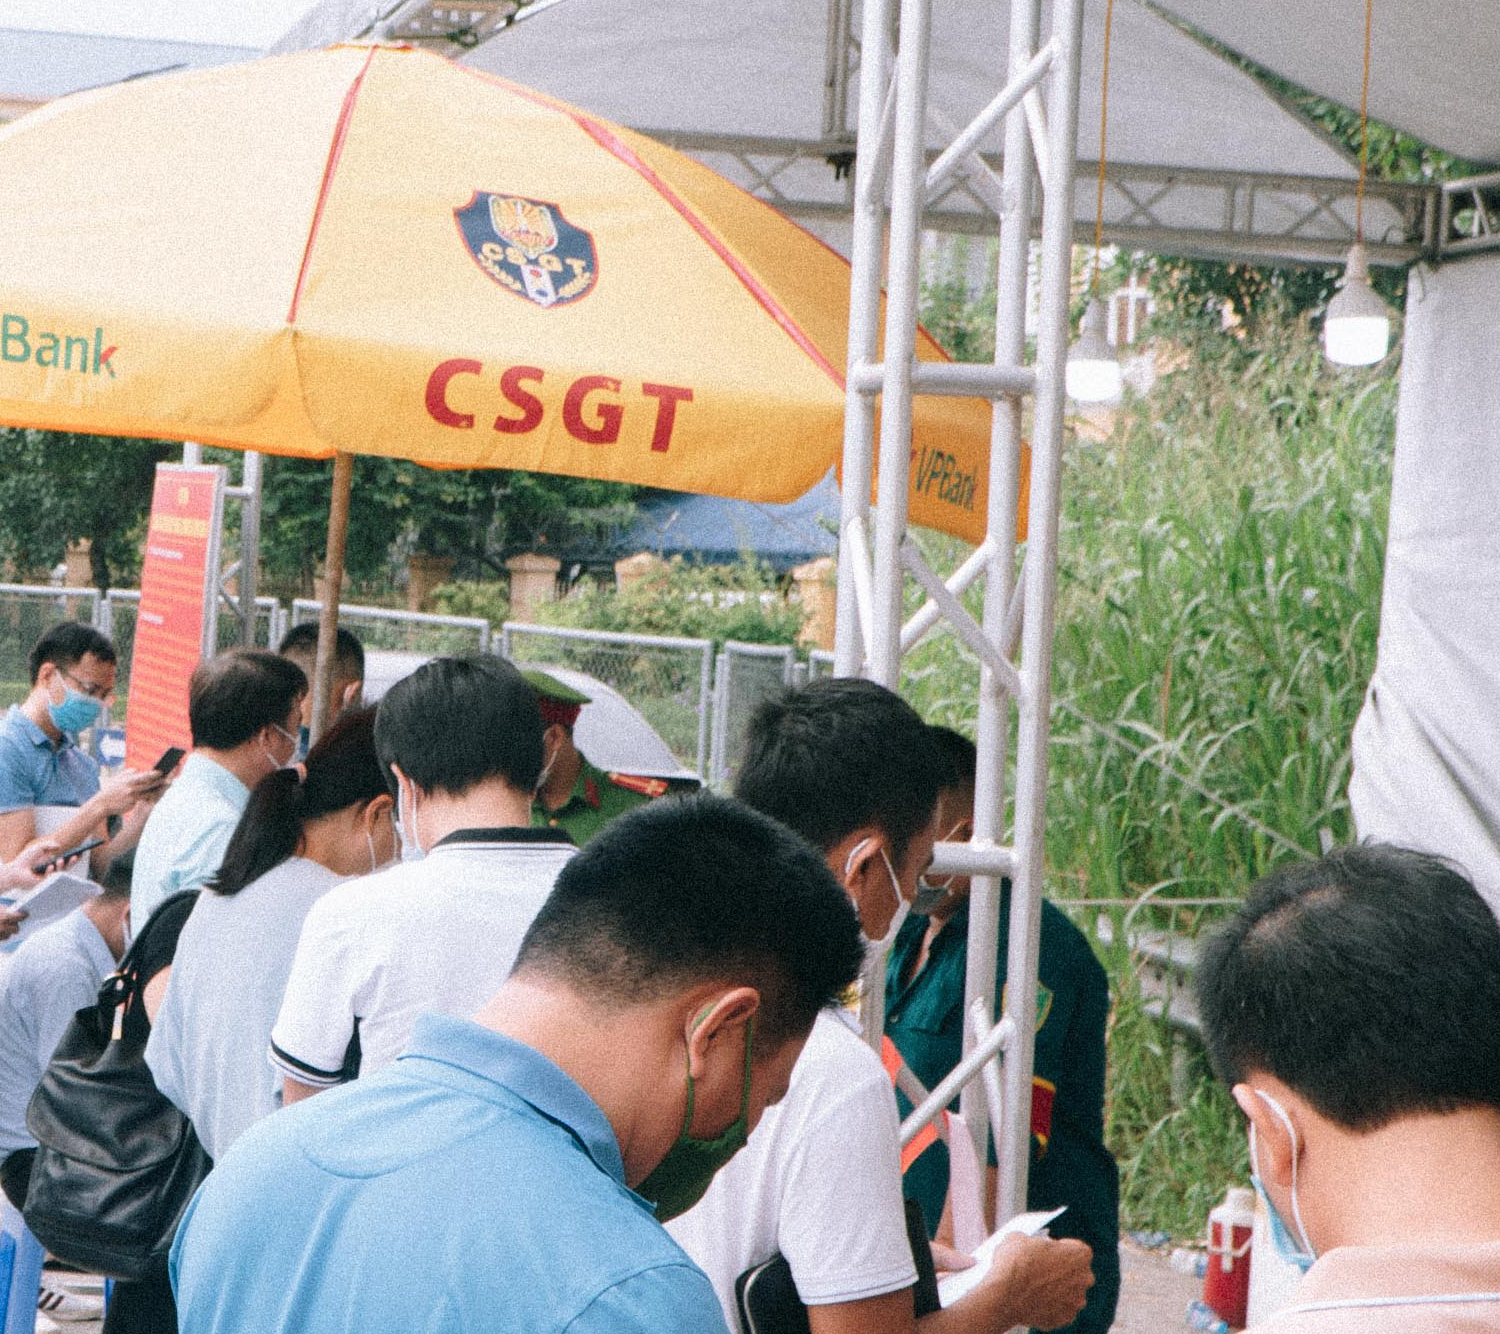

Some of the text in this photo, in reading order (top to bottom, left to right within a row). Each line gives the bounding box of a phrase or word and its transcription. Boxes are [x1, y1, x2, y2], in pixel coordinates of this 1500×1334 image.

[482, 242, 587, 276] CSGT
[424, 358, 694, 453] CSGT
[916, 444, 979, 512] VPBank
